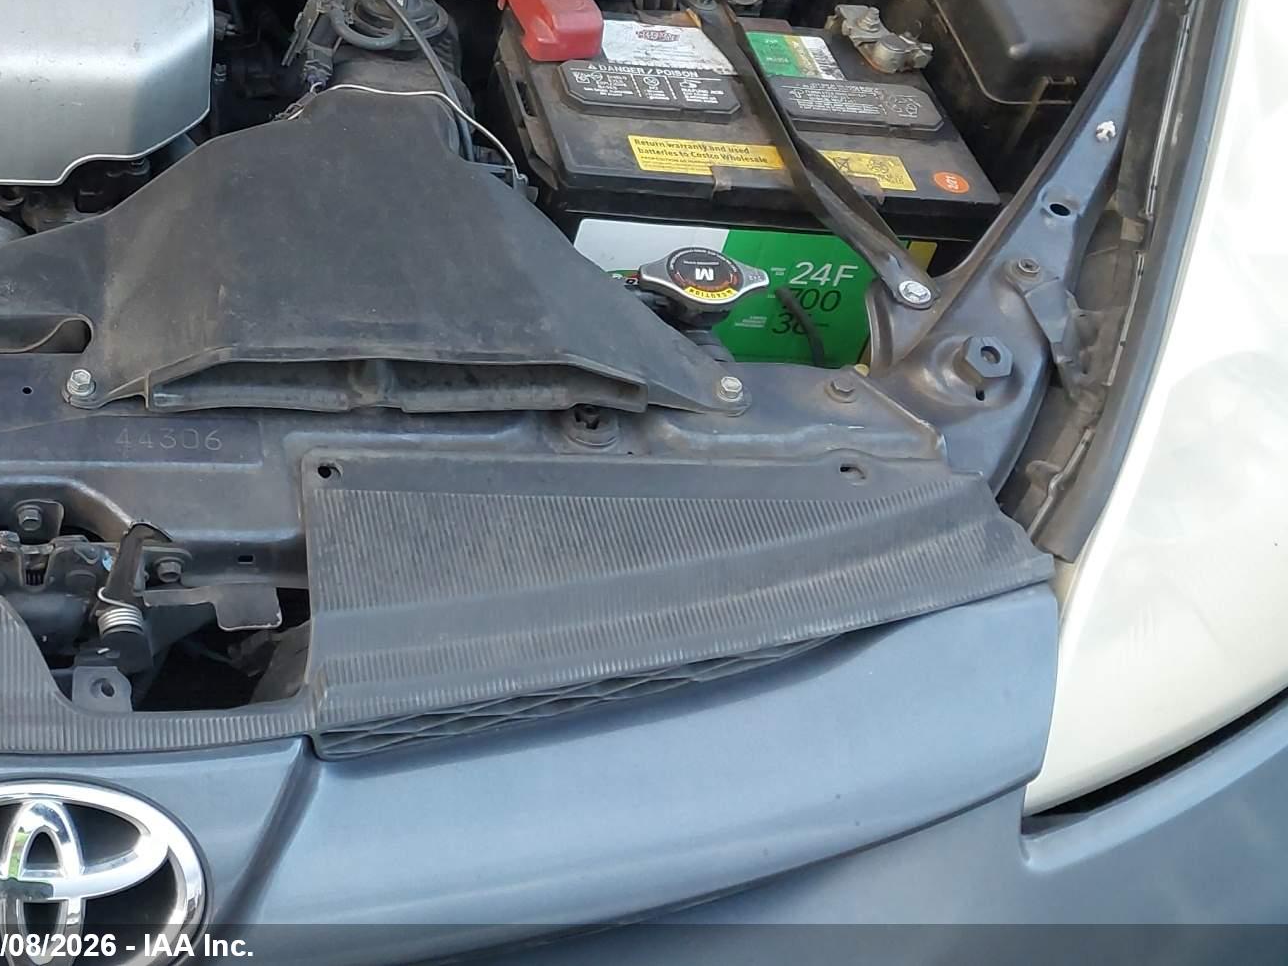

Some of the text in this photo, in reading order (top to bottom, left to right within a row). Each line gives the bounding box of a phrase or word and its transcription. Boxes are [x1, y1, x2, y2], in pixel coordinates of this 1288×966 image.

[599, 64, 645, 75] DANGER
[656, 68, 699, 78] POISON
[634, 139, 666, 148] Return
[667, 141, 707, 152] warranty
[729, 147, 750, 155] used
[638, 147, 679, 157] batteries
[691, 151, 721, 160] Costco
[722, 154, 768, 164] Wholesale
[789, 261, 859, 286] 24F
[115, 427, 223, 452] 44306
